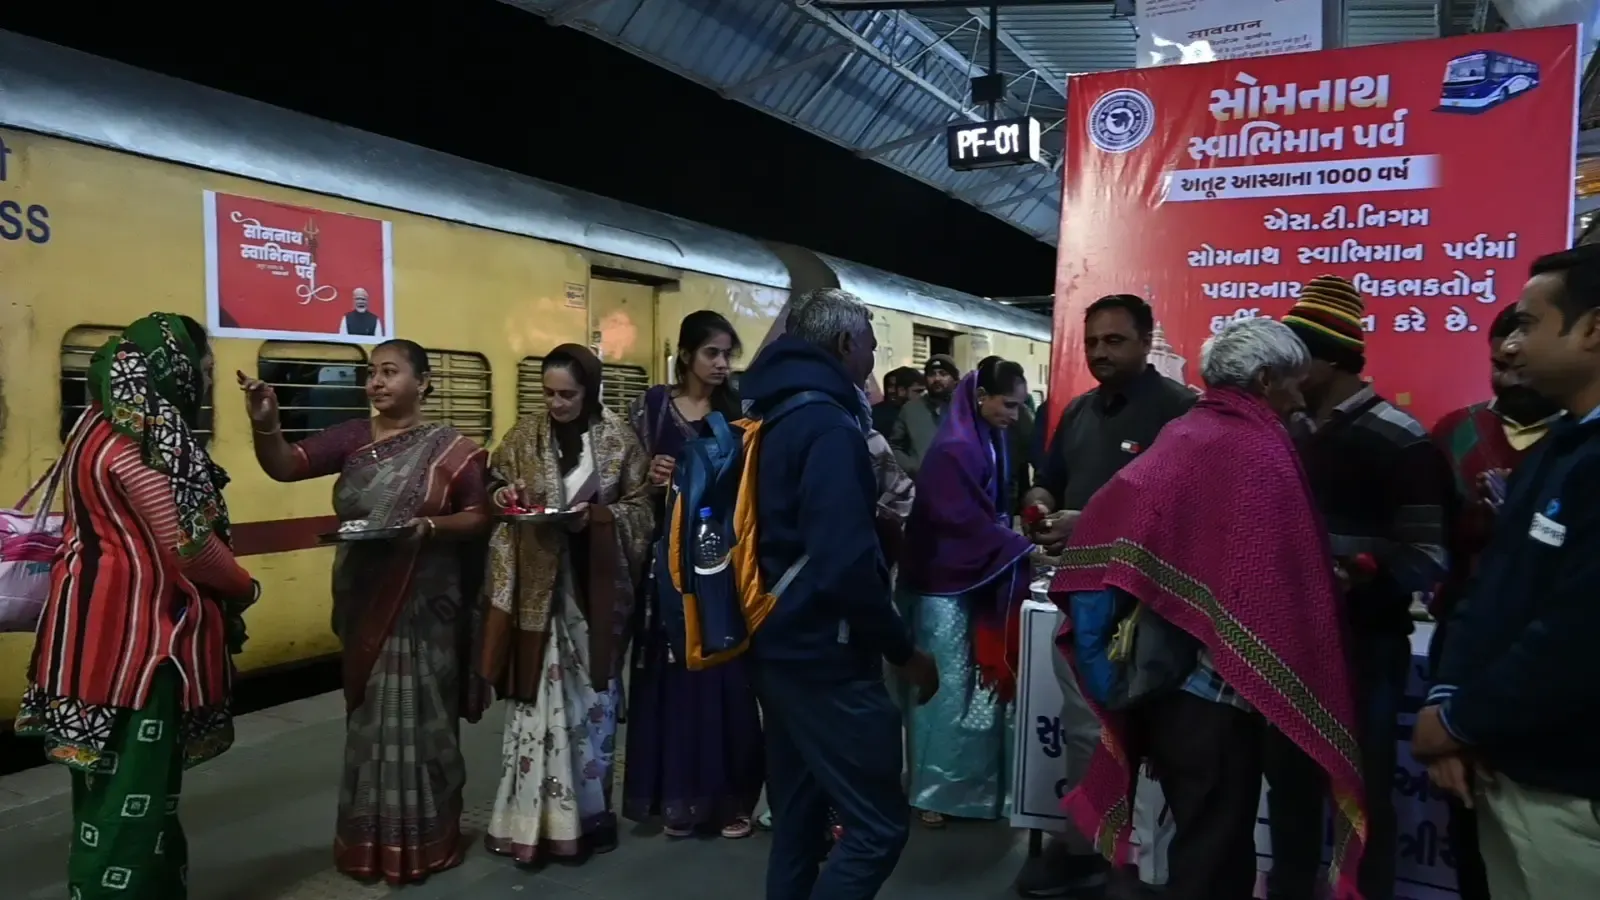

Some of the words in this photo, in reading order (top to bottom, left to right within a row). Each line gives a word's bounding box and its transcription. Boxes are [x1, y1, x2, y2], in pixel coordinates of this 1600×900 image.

[1186, 19, 1263, 39] सावधान
[1208, 71, 1390, 122] સોમનાથ
[957, 123, 1019, 159] PF-01
[1187, 120, 1344, 161] સ્વાભિમાન
[1352, 108, 1409, 149] પર્વ
[1181, 175, 1226, 198] અતૂટ
[1230, 170, 1311, 189] આસ્થાના
[1316, 166, 1372, 185] 1000
[1377, 158, 1411, 181] વર્ષ
[230, 211, 303, 245] सोमनाथ
[240, 242, 311, 267] स्वाभिमान
[1187, 243, 1280, 267] સોમનાથ
[1297, 238, 1424, 264] સ્વાભિમાન
[1442, 232, 1517, 260] પર્વમાં
[1201, 280, 1302, 299] પધારનાર
[1353, 269, 1497, 304] વિકભકતોનું
[1393, 306, 1427, 332] કરે
[1444, 306, 1479, 332] છે.
